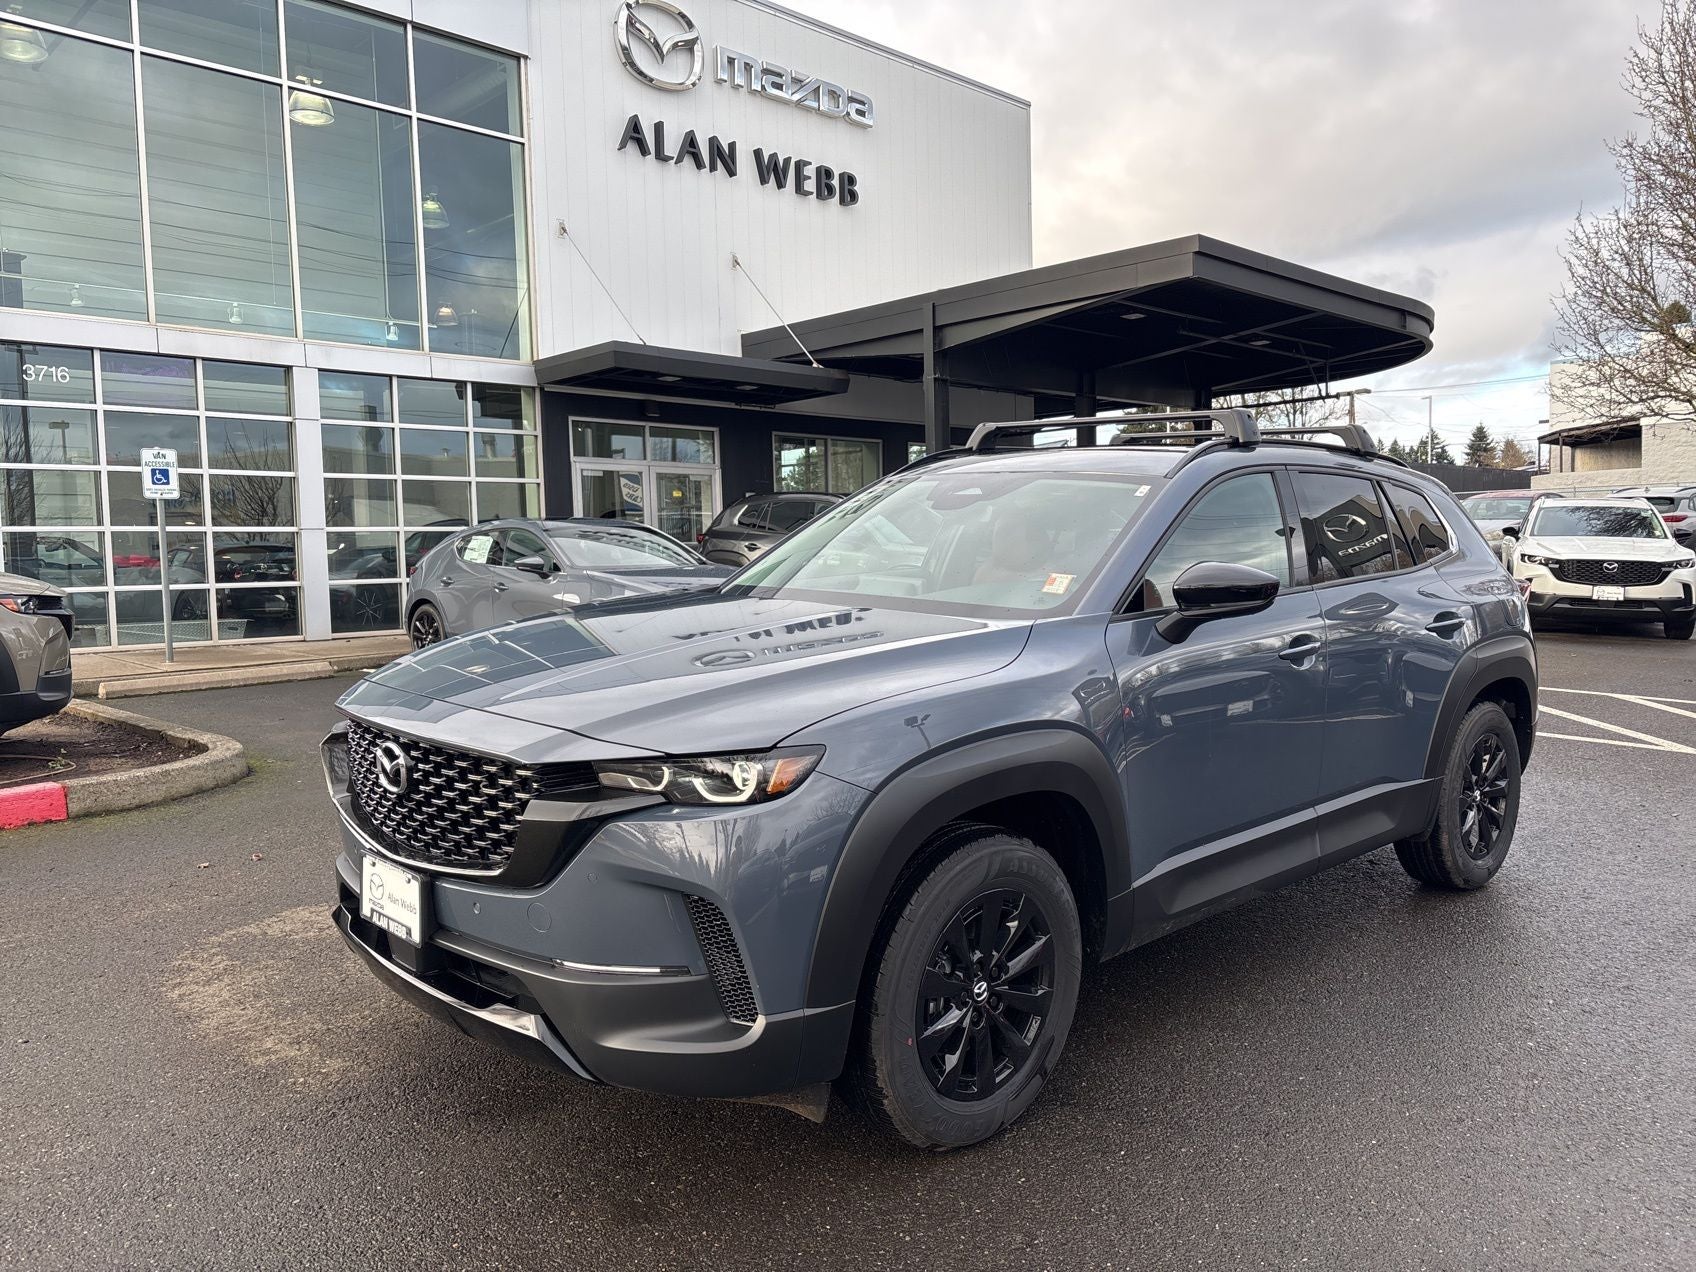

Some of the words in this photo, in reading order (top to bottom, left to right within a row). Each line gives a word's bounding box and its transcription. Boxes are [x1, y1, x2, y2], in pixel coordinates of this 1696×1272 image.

[713, 44, 874, 128] mazda
[617, 113, 737, 178] ALAN
[752, 147, 859, 206] WEBB
[22, 364, 70, 383] 3716
[144, 460, 176, 468] ACCESSIBLE
[152, 452, 167, 460] VAN
[387, 891, 400, 908] Alan
[372, 911, 389, 930] ALAN
